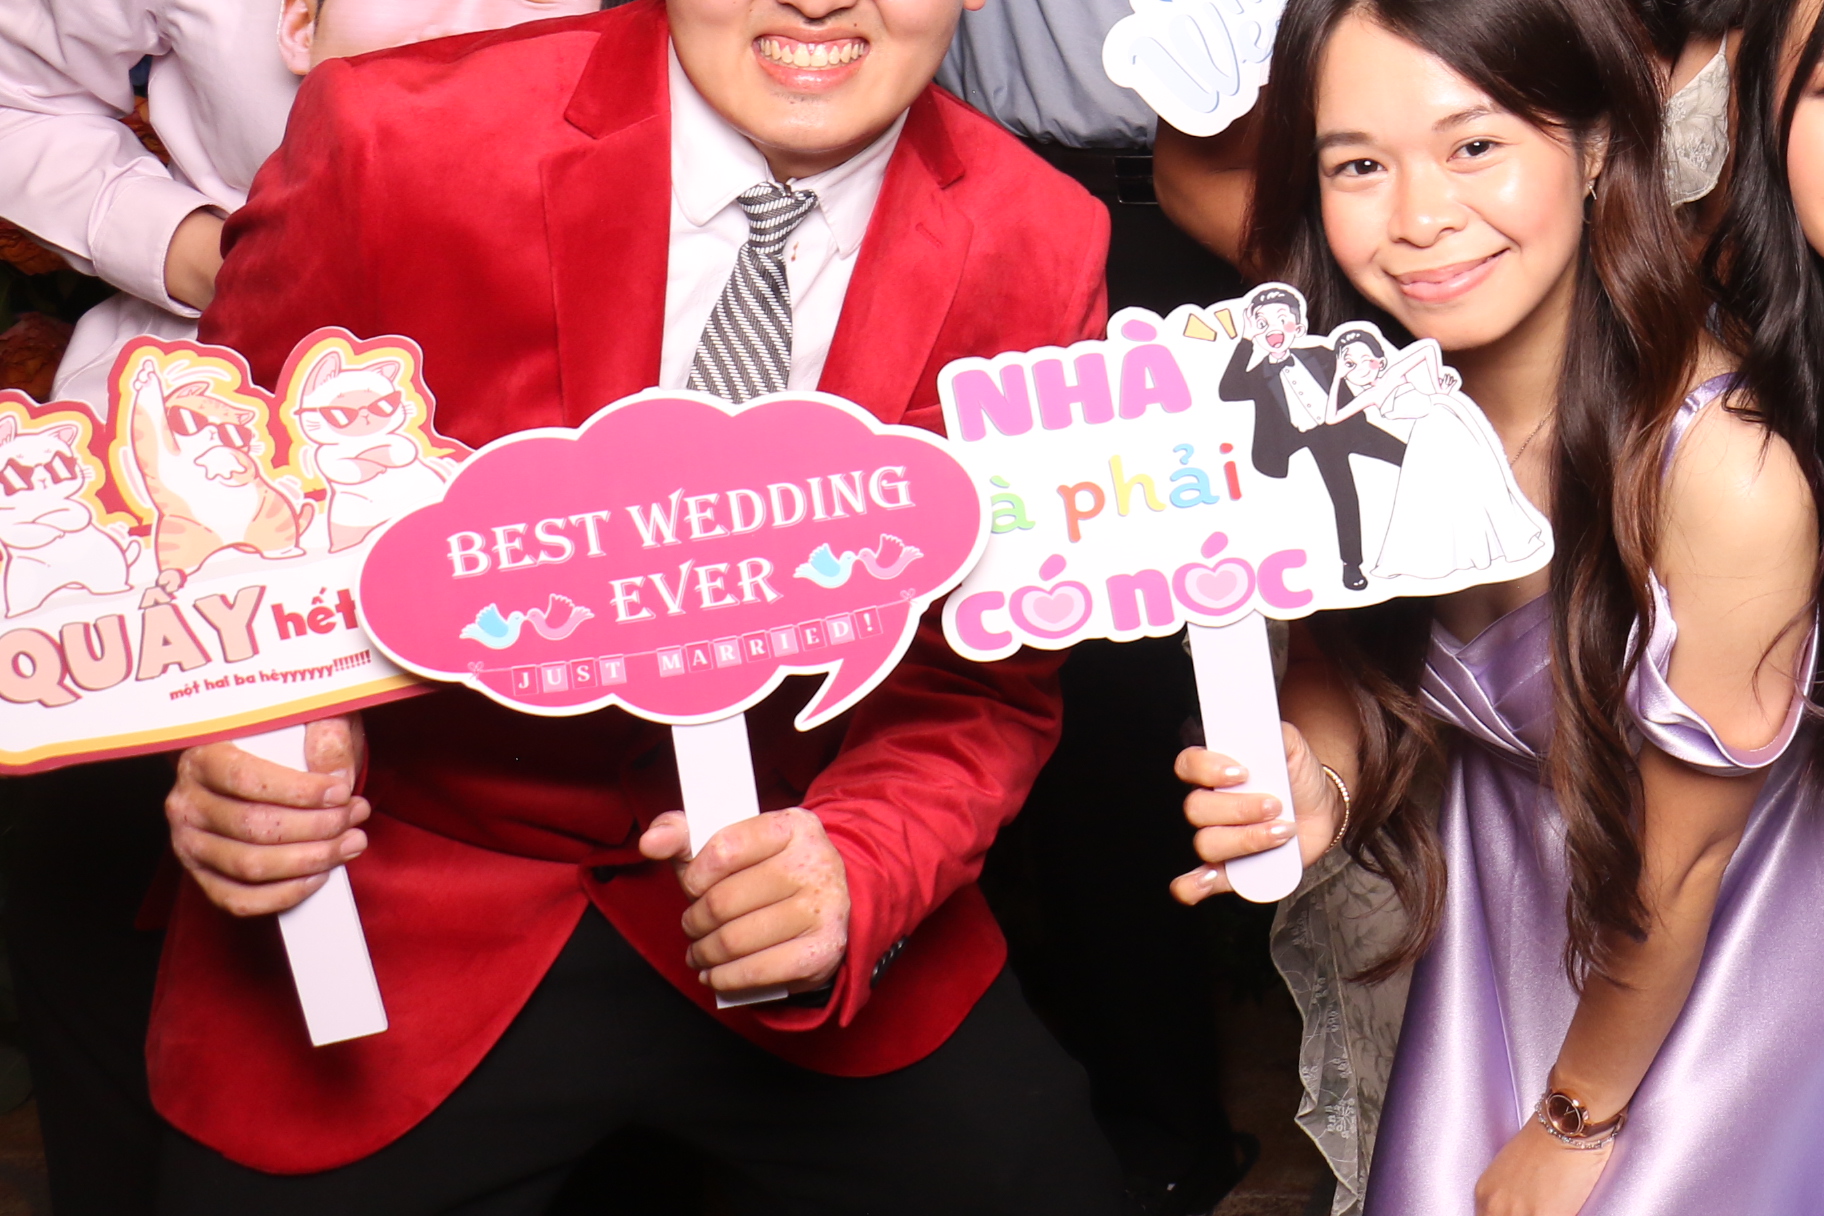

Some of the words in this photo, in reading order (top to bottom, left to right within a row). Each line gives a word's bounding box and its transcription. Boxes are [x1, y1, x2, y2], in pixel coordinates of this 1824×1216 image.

[952, 319, 1193, 442] NHÀ
[446, 510, 613, 579] BEST
[625, 465, 915, 551] WEDDING
[1056, 443, 1242, 544] phải
[271, 586, 359, 641] hết
[609, 554, 785, 624] EVER
[955, 553, 1093, 652] có
[1105, 531, 1314, 633] nóc
[203, 675, 231, 691] hai
[233, 673, 257, 686] ba
[516, 659, 625, 691] JUST
[660, 611, 876, 673] MARRIED!
